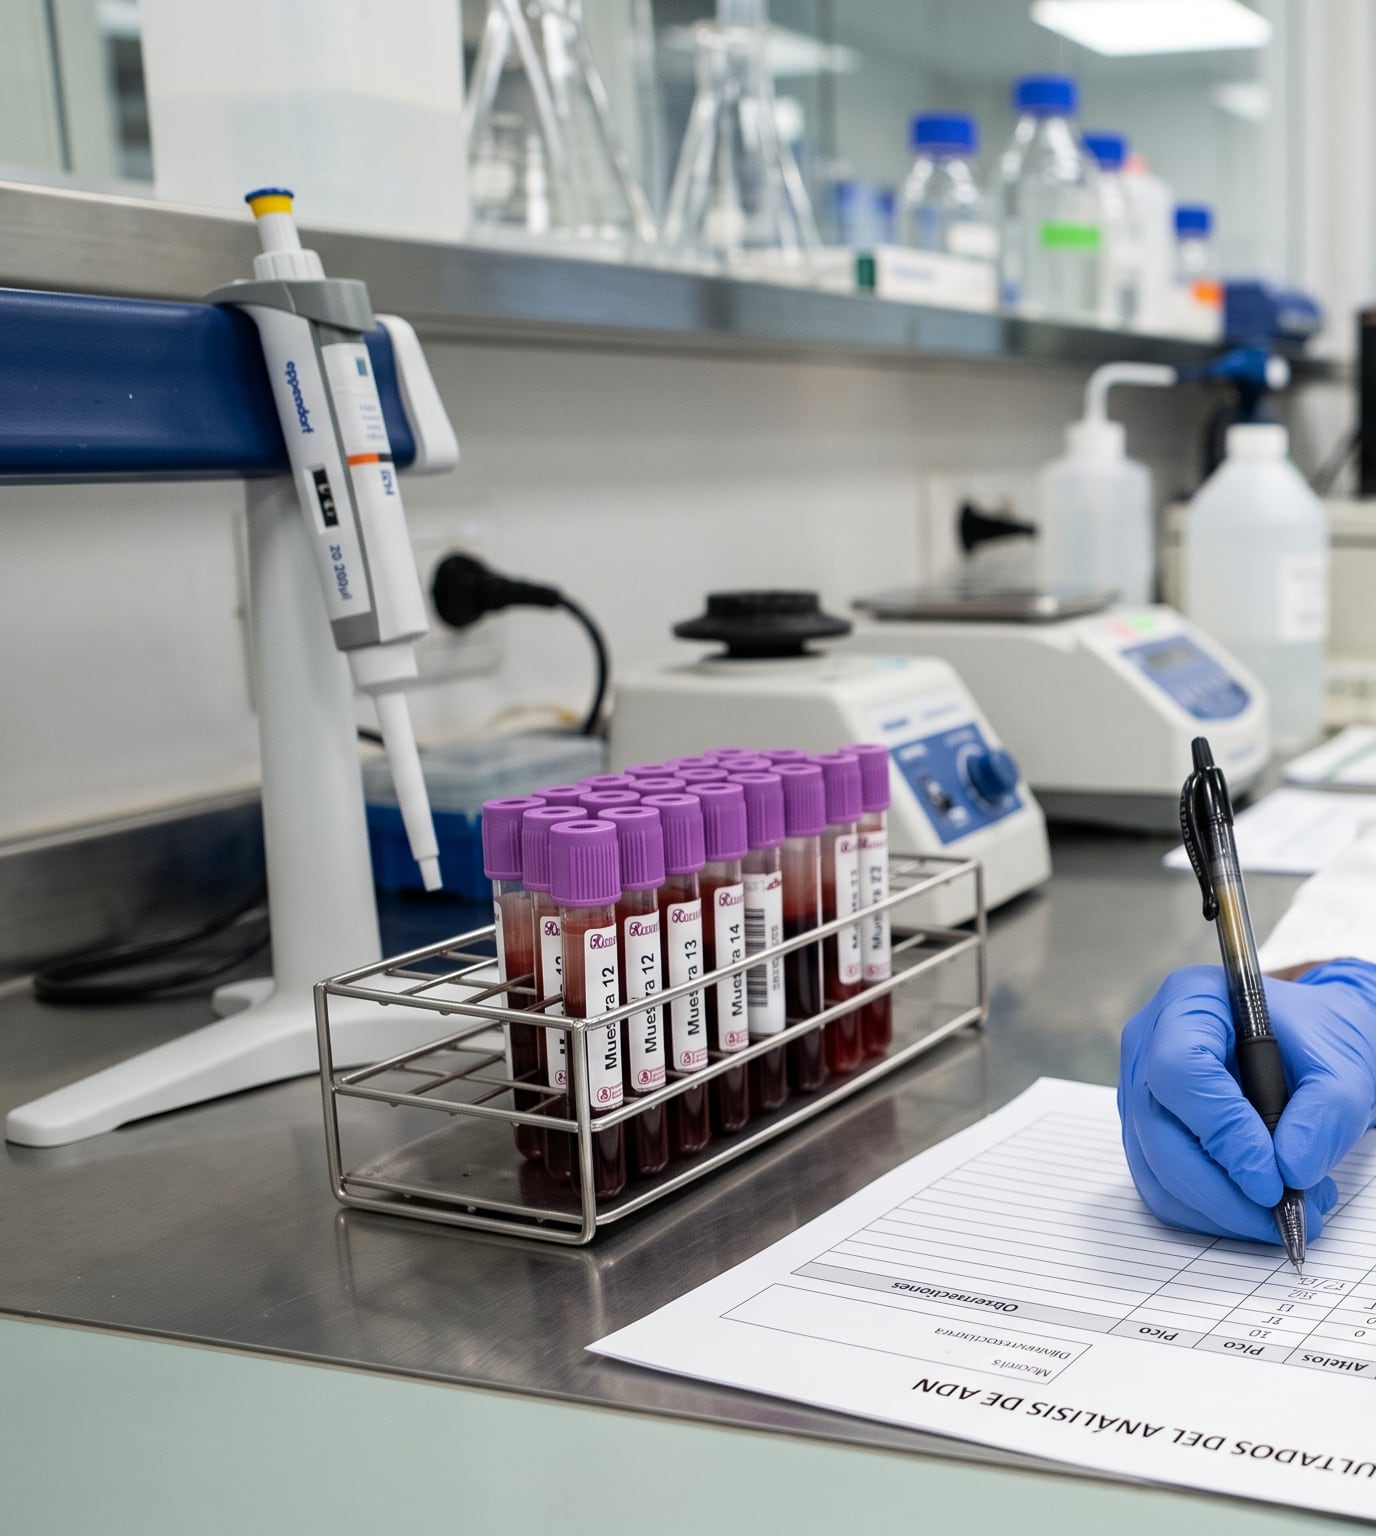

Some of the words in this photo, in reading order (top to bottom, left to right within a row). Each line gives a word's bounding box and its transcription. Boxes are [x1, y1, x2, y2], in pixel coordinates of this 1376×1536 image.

[729, 923, 740, 944] 14
[684, 939, 697, 959] 13
[640, 953, 655, 975] 12
[601, 965, 615, 987] 12
[911, 1377, 983, 1401] ADN
[980, 1392, 1023, 1412] DE
[1026, 1400, 1165, 1440] ANÁLISIS
[1172, 1427, 1226, 1451] DEL
